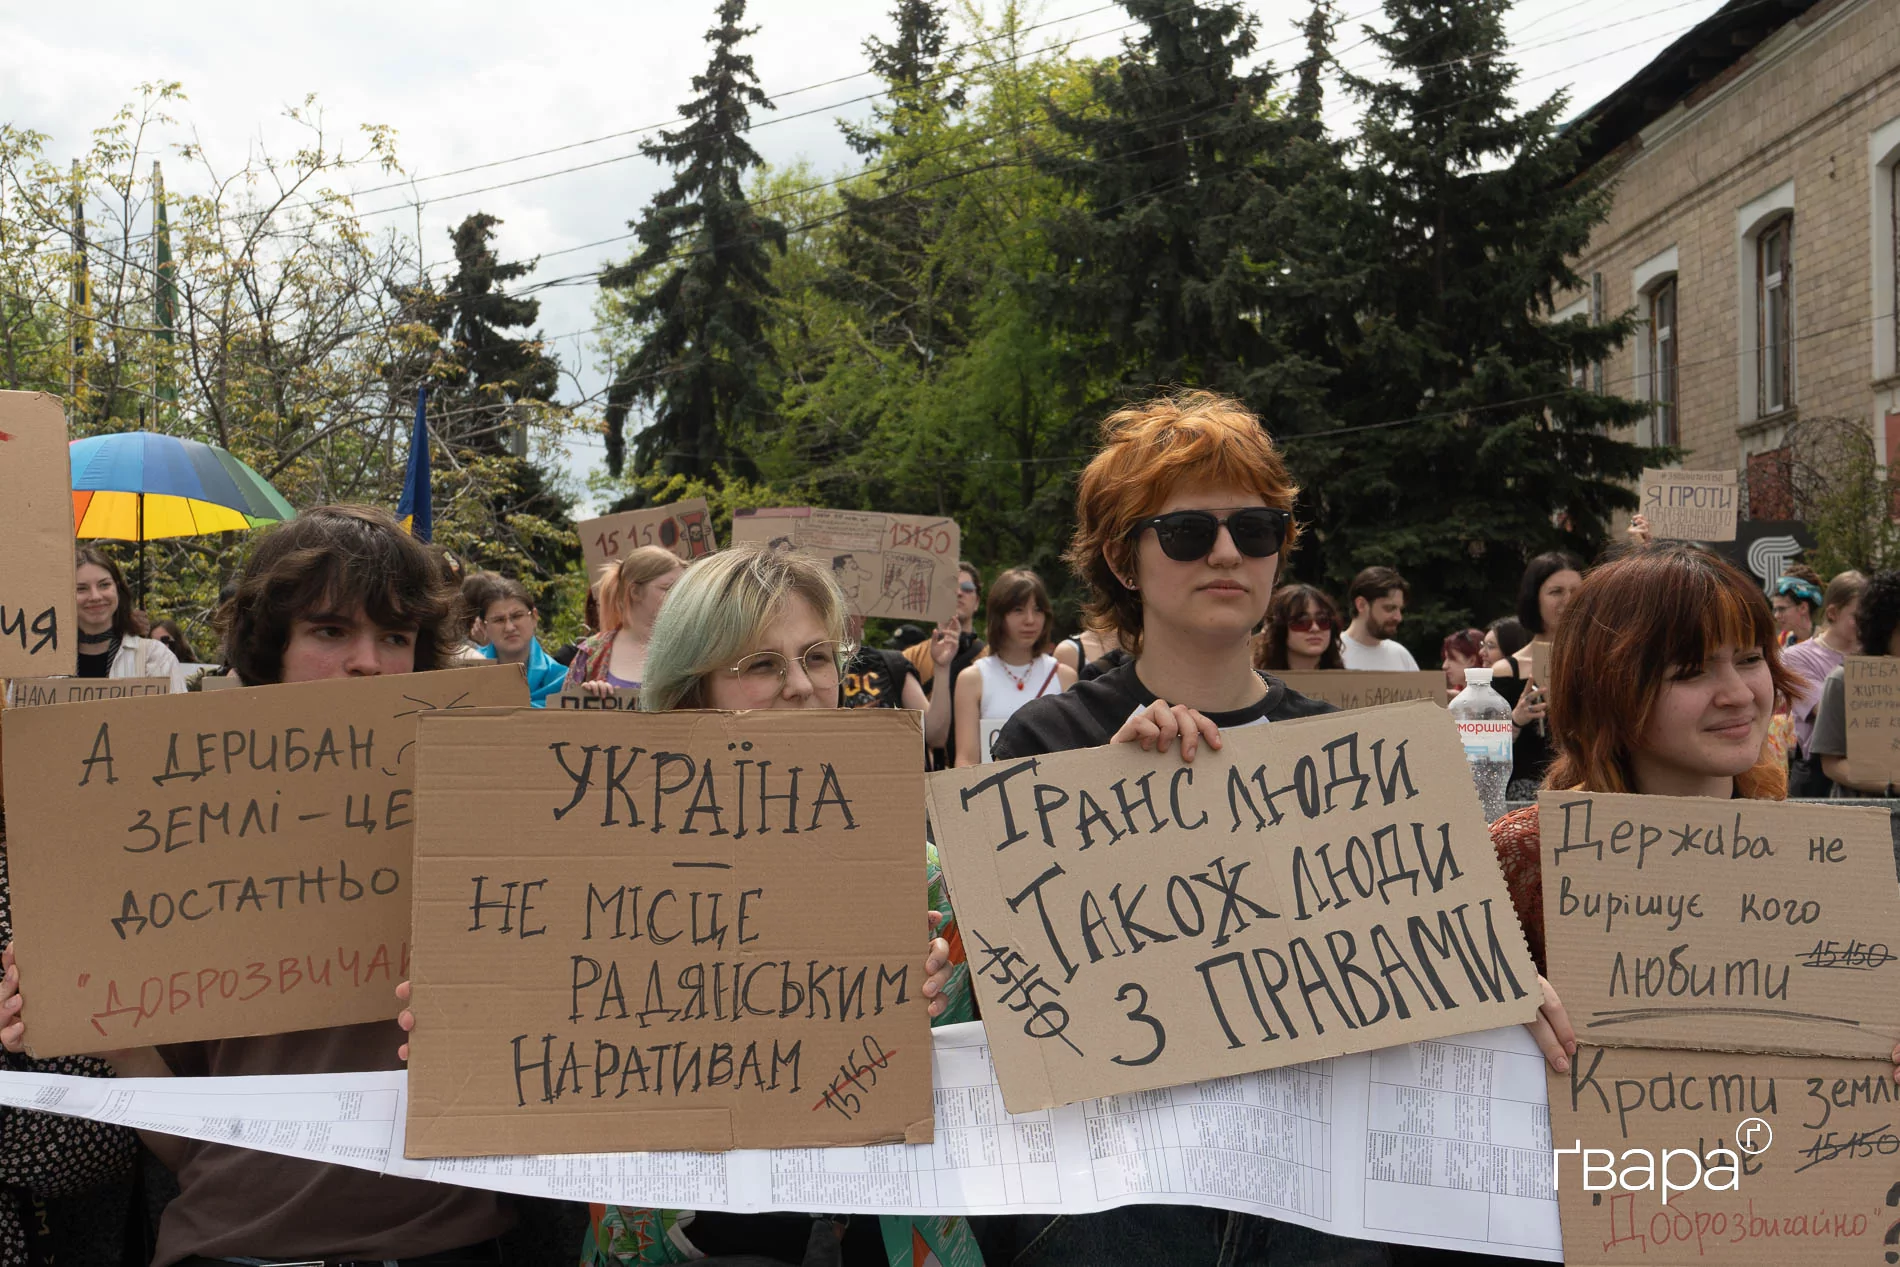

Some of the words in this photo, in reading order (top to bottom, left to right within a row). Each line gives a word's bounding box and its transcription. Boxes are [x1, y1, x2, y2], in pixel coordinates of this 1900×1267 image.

[1644, 484, 1662, 507] Я
[1668, 486, 1733, 509] ПРОТИ
[889, 520, 951, 554] 15150
[15, 684, 57, 707] НАМ
[79, 722, 119, 786] А
[152, 725, 374, 788] ДЕРИБАН
[548, 741, 861, 839] УКРАЇНА
[960, 757, 1209, 852] ТРАНС
[1226, 731, 1420, 834] ЛЮДИ
[345, 788, 414, 834] ЦЕ
[1808, 836, 1848, 863] не
[111, 859, 400, 940] ДОСТАТНЬО
[468, 875, 549, 939] НЕ
[582, 882, 764, 950] МІСЦЕ
[1006, 855, 1281, 985] ТАКОЖ
[1293, 822, 1465, 922] ЛЮДИ
[1741, 893, 1821, 925] кого
[568, 955, 909, 1028] РАДЯНСЬКИМ
[1194, 898, 1529, 1050] ПРАВАМИ
[1797, 939, 1898, 972] 15150
[510, 1033, 802, 1107] НАРАТИВАМ
[812, 1034, 897, 1121] 15150
[1570, 1048, 1778, 1138] Красти
[1796, 1124, 1900, 1173] 15150
